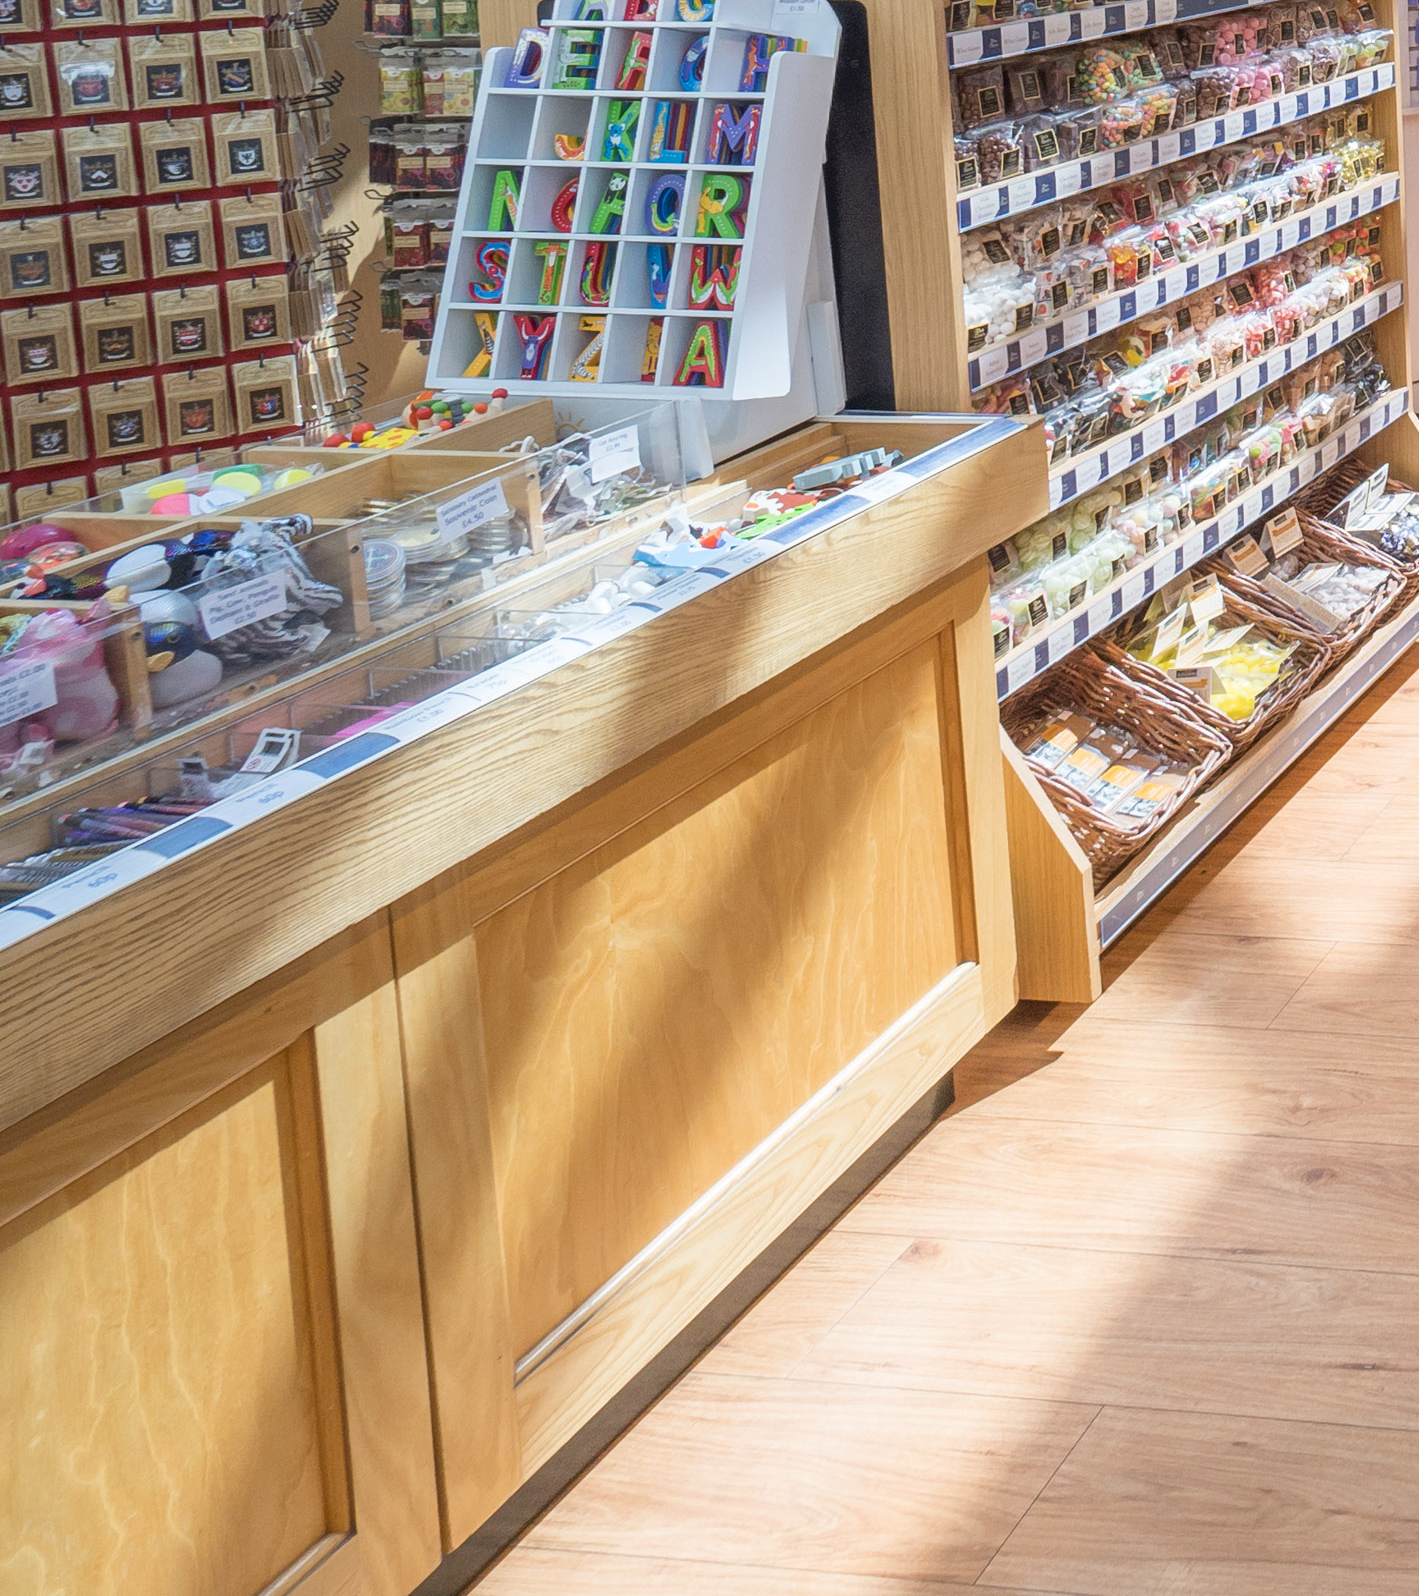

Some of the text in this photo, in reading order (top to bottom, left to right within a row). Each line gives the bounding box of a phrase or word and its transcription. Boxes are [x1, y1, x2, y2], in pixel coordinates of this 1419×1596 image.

[697, 174, 745, 238] R
[445, 495, 497, 525] Souvenir Coin
[462, 511, 484, 527] £4.50
